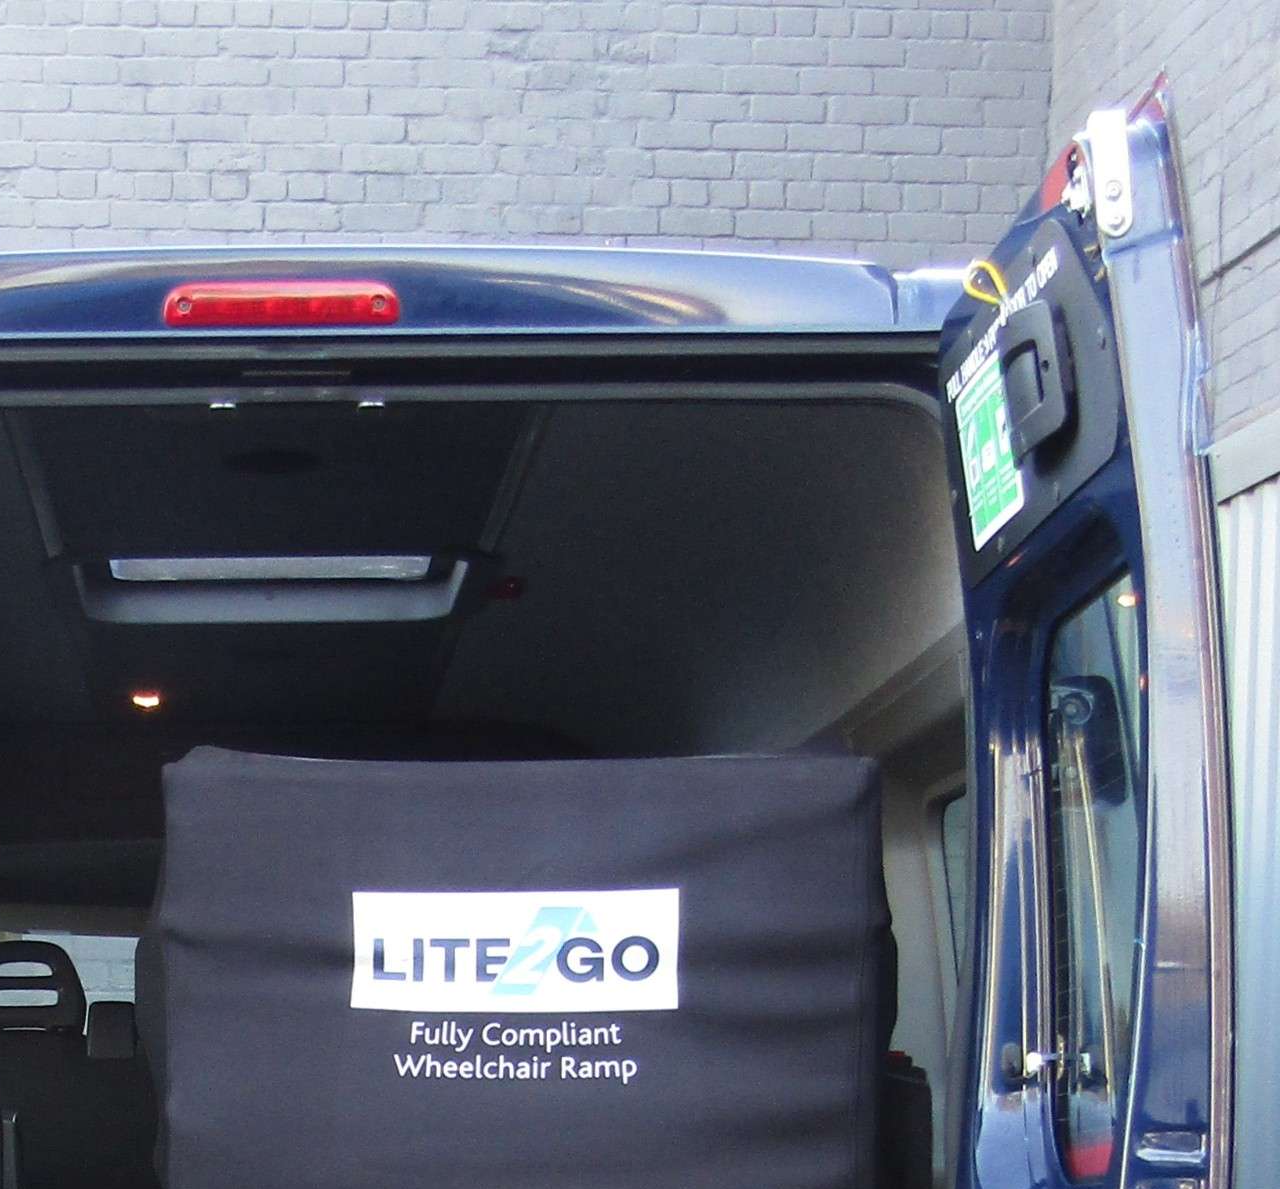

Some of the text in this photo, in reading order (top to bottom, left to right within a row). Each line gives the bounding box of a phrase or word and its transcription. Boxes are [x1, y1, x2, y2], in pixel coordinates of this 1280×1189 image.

[1036, 247, 1059, 289] OPEN
[373, 922, 660, 986] LITE2GO
[410, 1021, 622, 1052] Fully Compliant
[394, 1054, 638, 1084] Wheelchair Ramp
